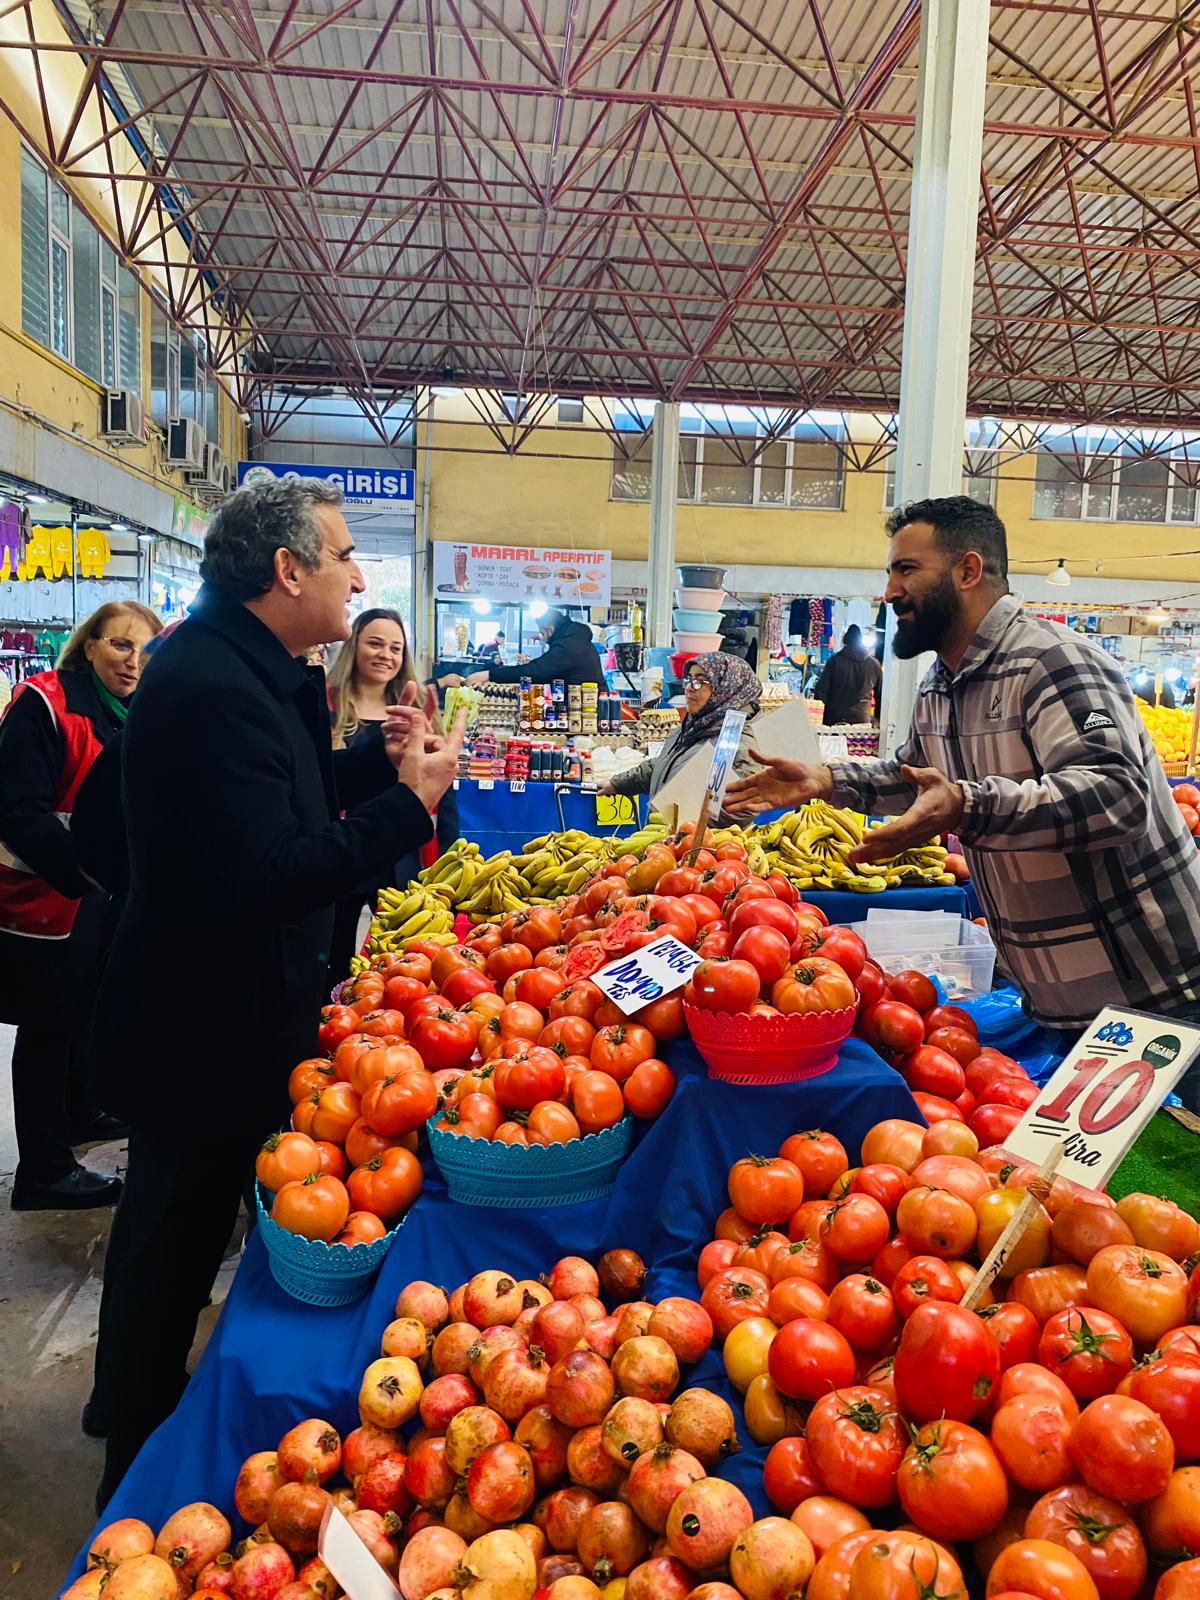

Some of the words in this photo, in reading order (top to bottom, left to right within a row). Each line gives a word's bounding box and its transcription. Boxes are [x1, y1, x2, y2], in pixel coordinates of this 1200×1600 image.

[326, 470, 407, 498] GİRİŞİ
[471, 546, 540, 562] MARAL
[543, 551, 605, 565] APERATİF
[647, 940, 701, 974] PEMBE
[1035, 1056, 1155, 1136] 10
[1062, 1133, 1103, 1167] lira
